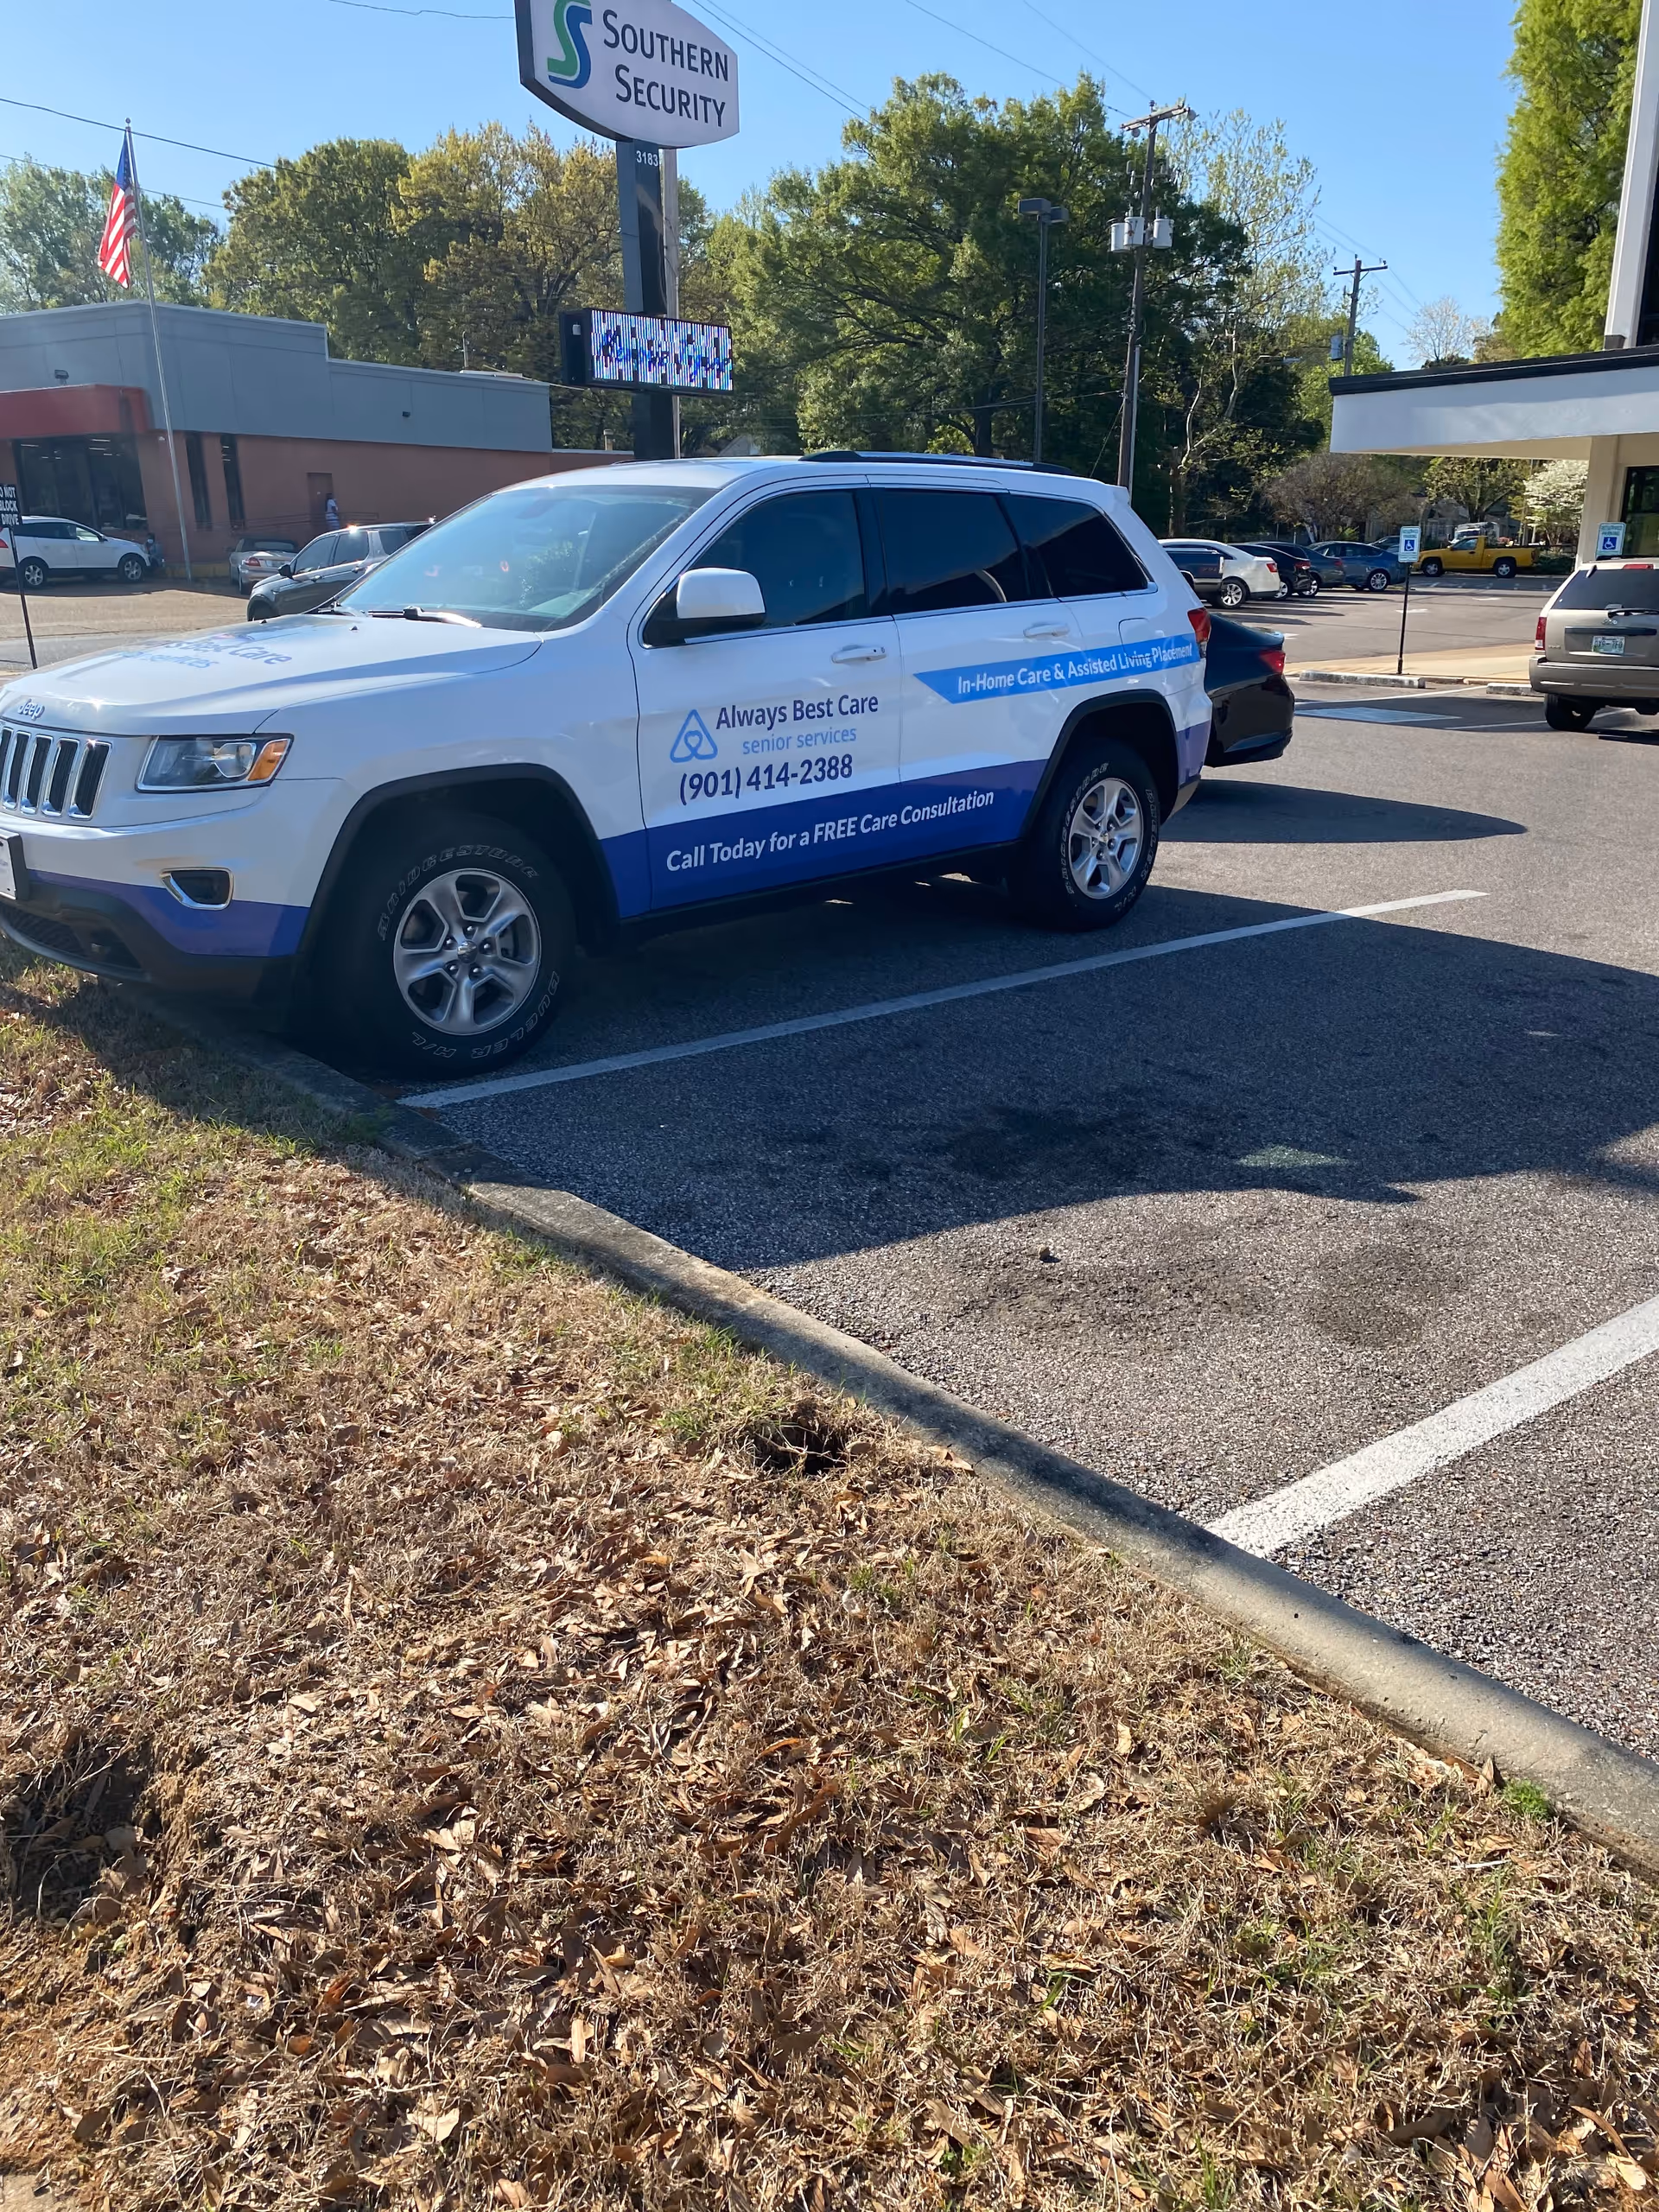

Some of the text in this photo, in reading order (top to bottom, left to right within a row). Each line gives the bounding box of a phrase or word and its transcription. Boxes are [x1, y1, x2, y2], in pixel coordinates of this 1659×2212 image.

[602, 10, 728, 82] SOUTHERN
[614, 64, 726, 127] SECURITY
[636, 149, 658, 167] 3183
[3, 486, 16, 499] NOT
[1, 513, 20, 526] DRIVE
[229, 646, 292, 664] Care
[958, 643, 1192, 695] In-Home Care & Assisted Living Placement
[715, 695, 879, 731] Always Best Care
[742, 727, 857, 755] senior services
[680, 753, 854, 805] (901) 414-2388
[666, 790, 995, 872] Call Today for a FREE Care Consultation
[378, 844, 539, 941] BRIDGESTONE
[471, 970, 560, 1059] DUELER
